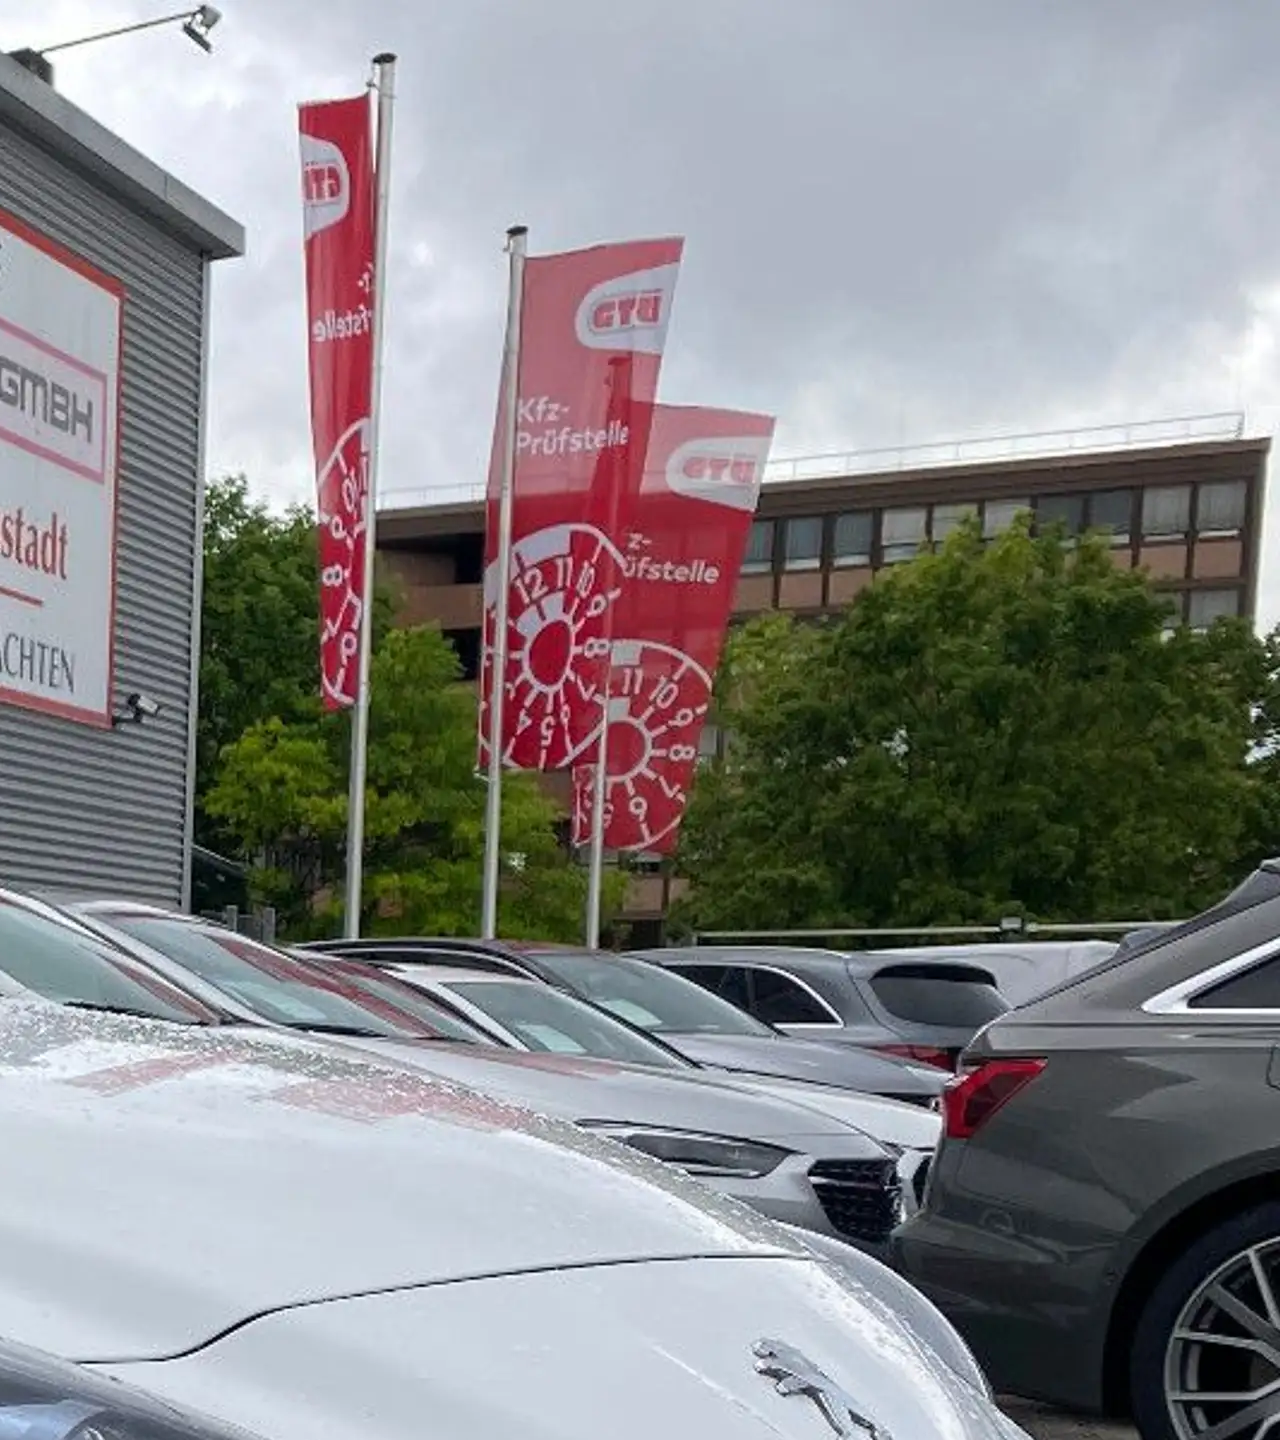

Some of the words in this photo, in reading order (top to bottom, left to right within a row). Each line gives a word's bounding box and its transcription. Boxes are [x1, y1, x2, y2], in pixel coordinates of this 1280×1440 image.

[516, 396, 570, 424] Kfz-
[516, 419, 630, 456] Prüfstelle
[623, 556, 721, 585] üfstelle
